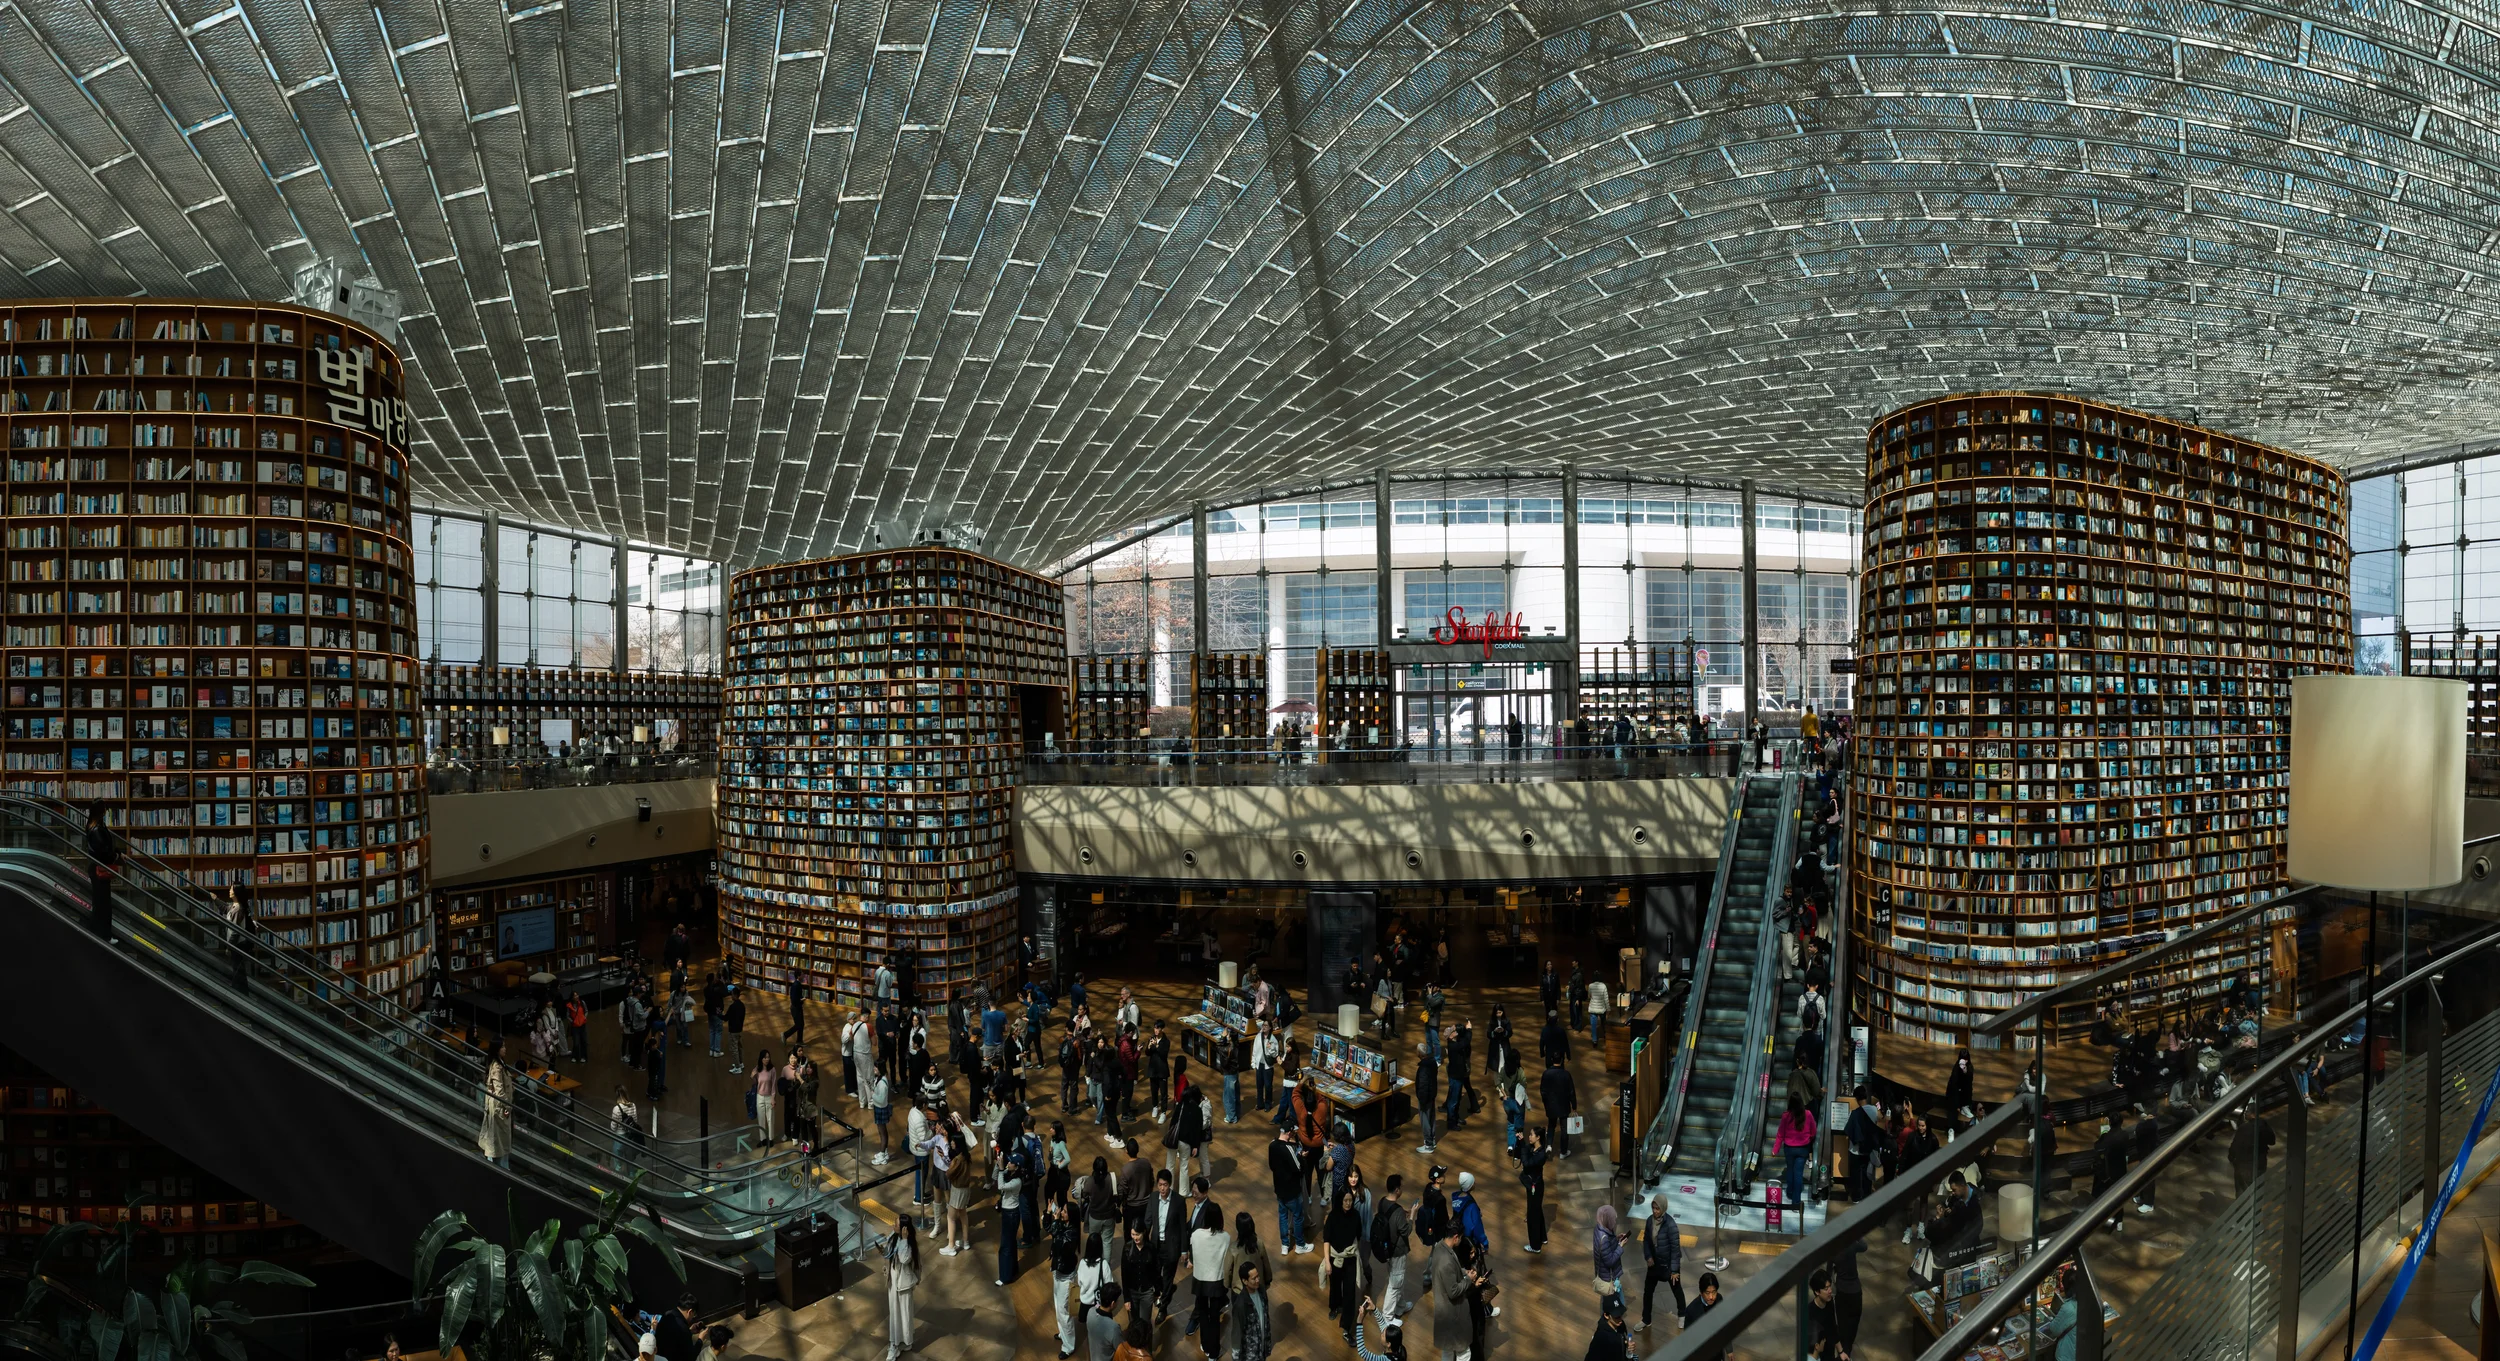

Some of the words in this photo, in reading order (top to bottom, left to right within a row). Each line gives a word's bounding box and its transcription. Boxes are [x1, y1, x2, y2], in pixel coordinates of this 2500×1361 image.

[1434, 605, 1523, 660] Starfield
[710, 861, 717, 871] B
[2103, 873, 2110, 887] C
[1882, 889, 1889, 903] C
[431, 955, 441, 970] A
[432, 981, 445, 998] A
[431, 1008, 447, 1018] 소설
